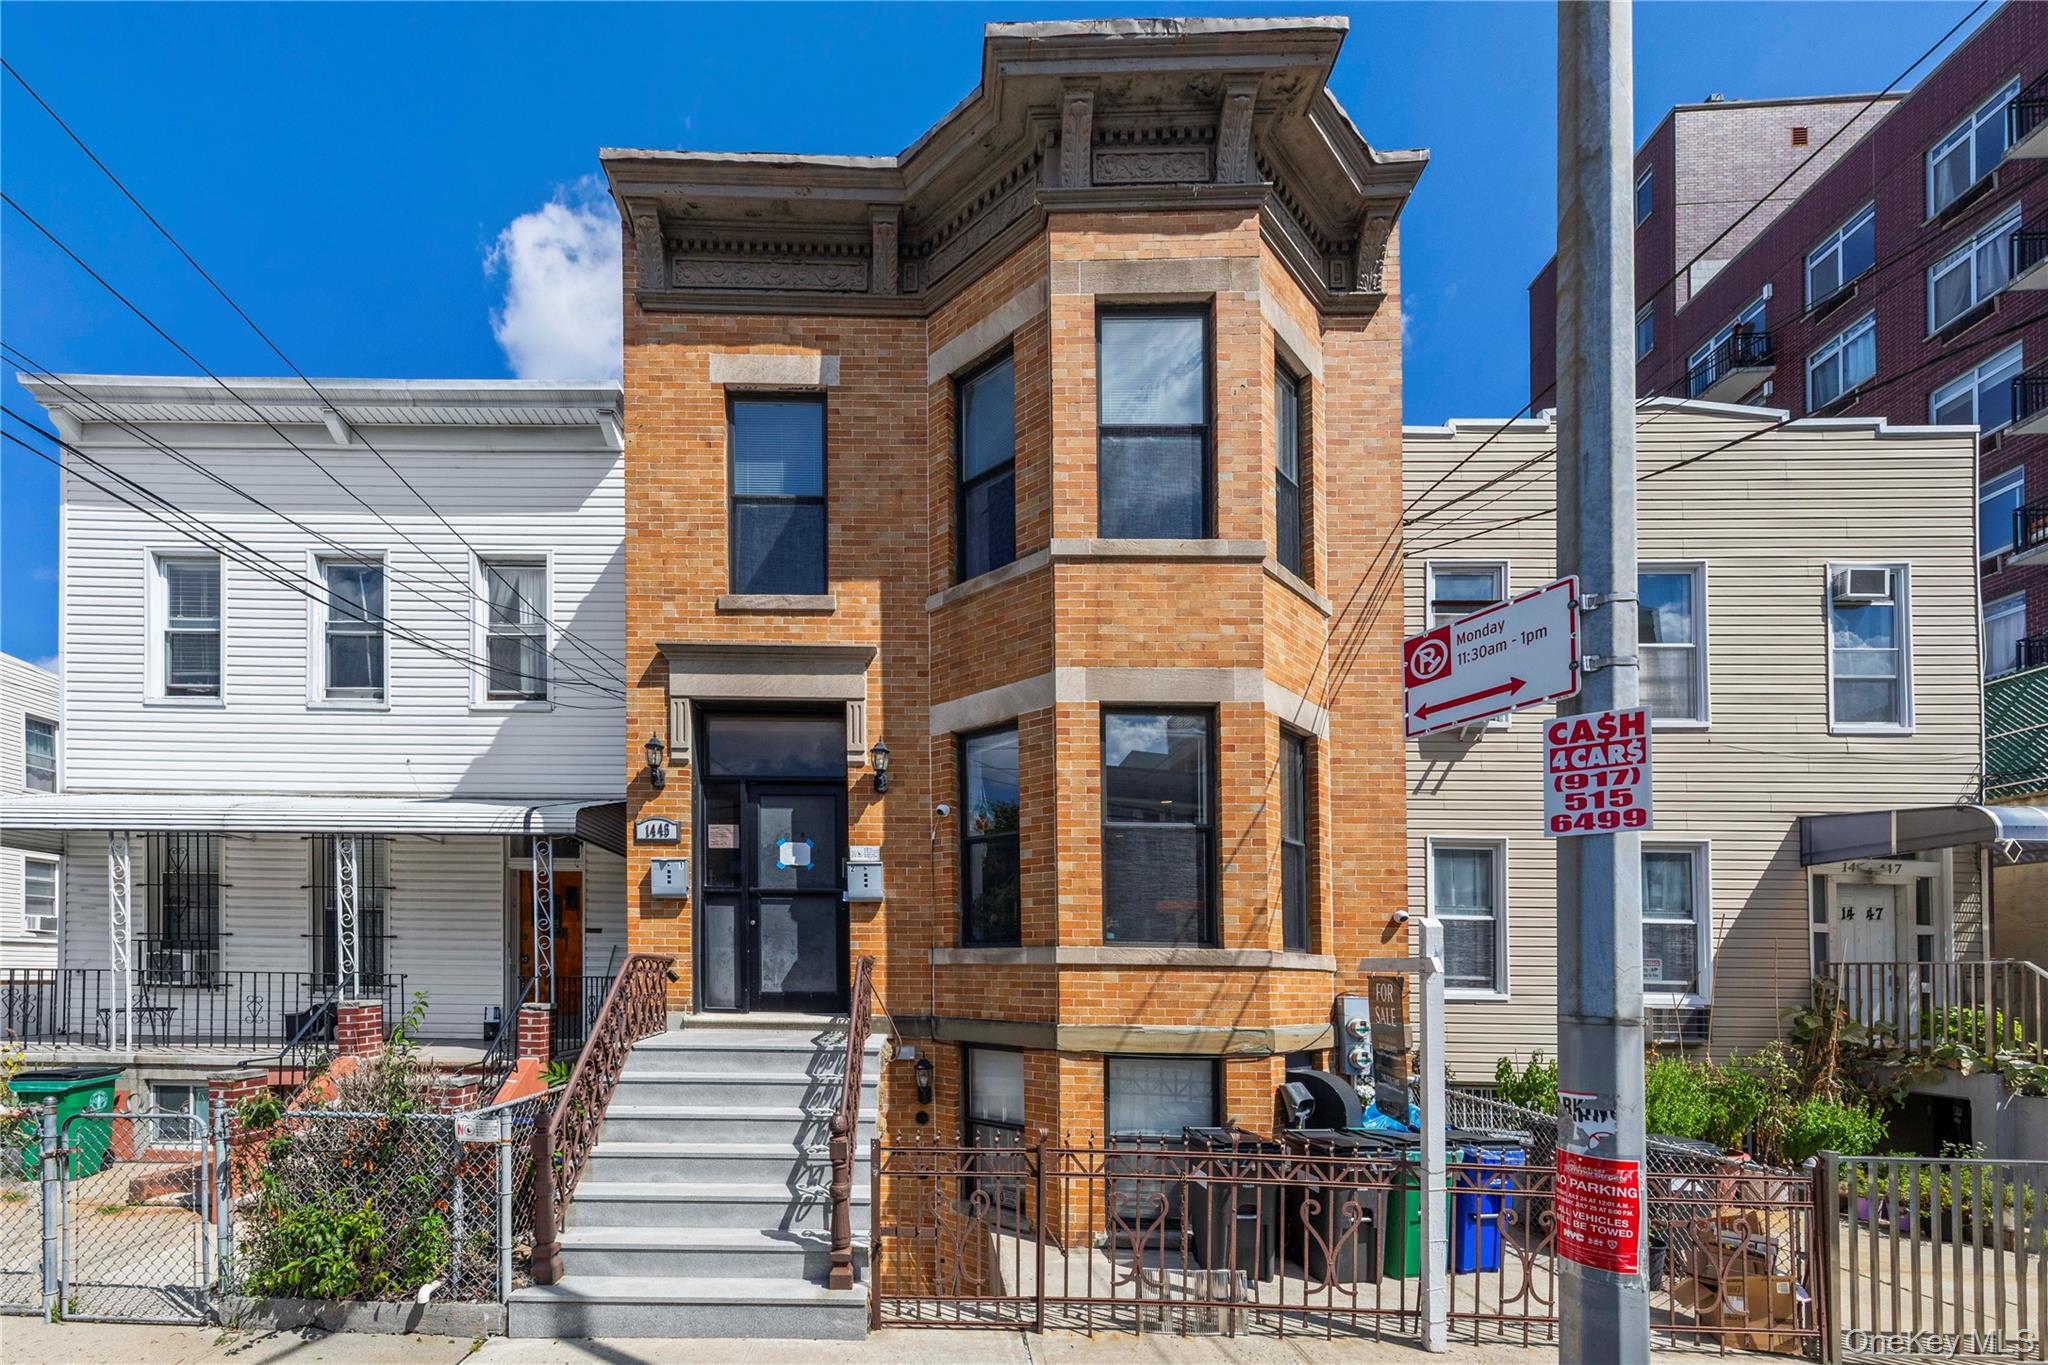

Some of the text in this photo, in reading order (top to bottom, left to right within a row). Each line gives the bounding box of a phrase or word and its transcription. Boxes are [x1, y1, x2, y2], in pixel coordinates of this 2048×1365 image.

[1456, 620, 1505, 646] Monday
[1457, 640, 1507, 665] 11:30am
[1520, 626, 1548, 646] 1pm
[1548, 712, 1645, 745] CA$H
[1554, 767, 1640, 793] (917)
[1565, 788, 1633, 811] 515
[1551, 808, 1647, 832] 6499
[1841, 907, 1884, 920] 14 47
[1375, 983, 1394, 1003] FOR
[1375, 1005, 1397, 1027] SALE
[1569, 1177, 1638, 1199] PARKING
[1557, 1204, 1630, 1229] ALL VEHICLES
[1573, 1219, 1588, 1231] BE
[1590, 1223, 1634, 1238] TOWED
